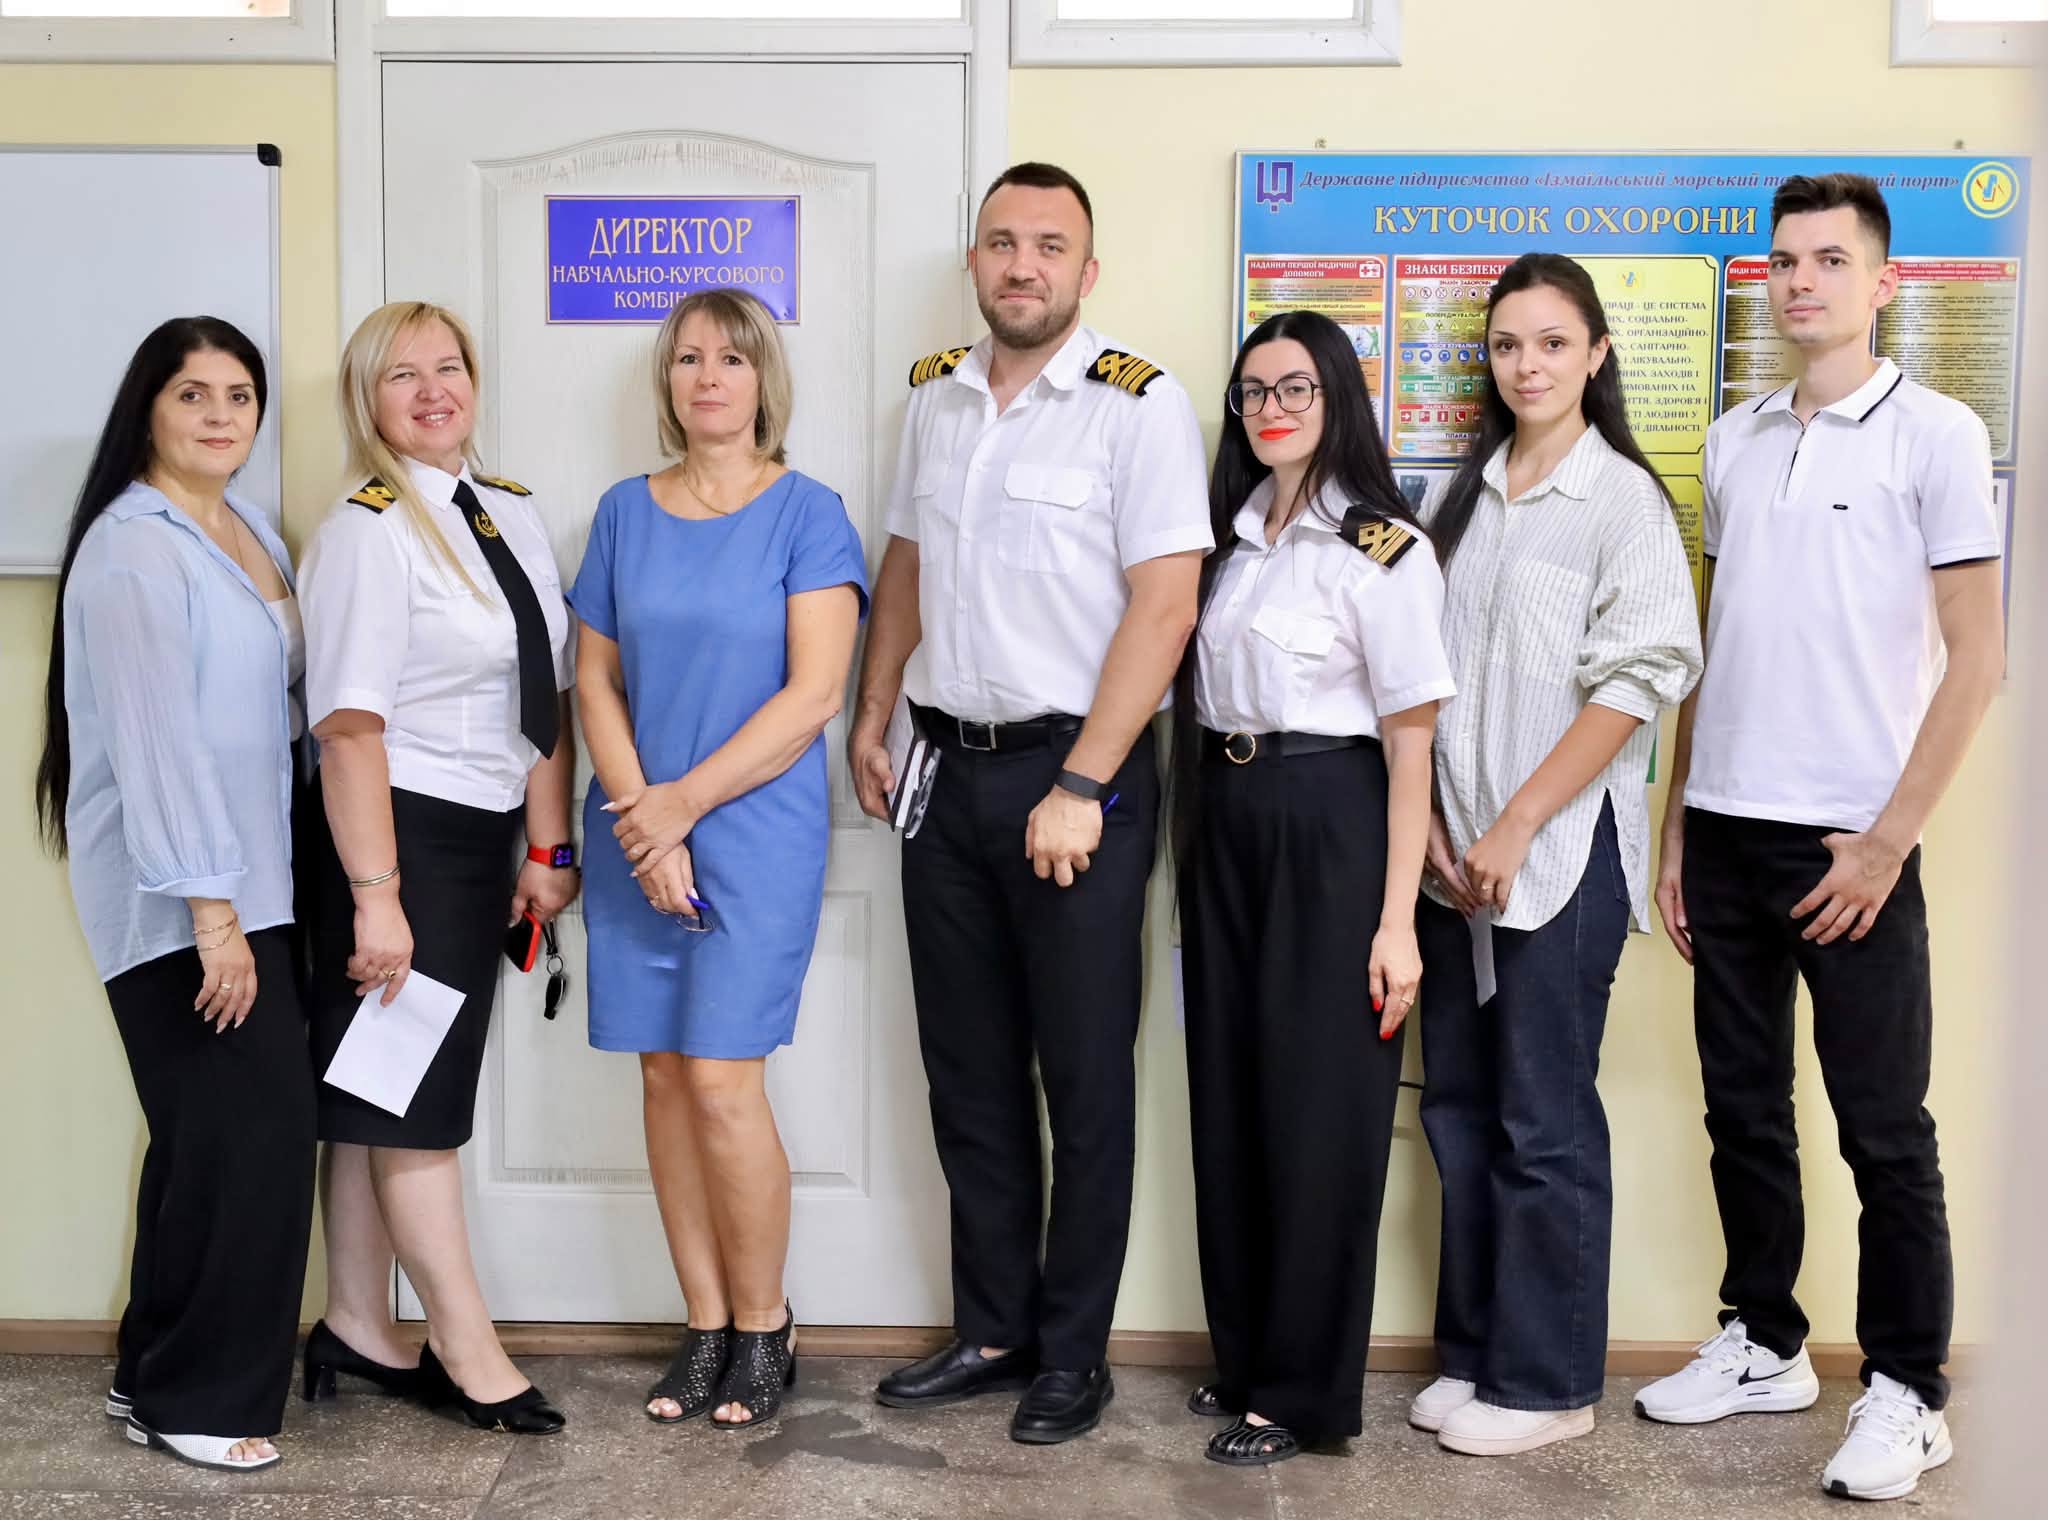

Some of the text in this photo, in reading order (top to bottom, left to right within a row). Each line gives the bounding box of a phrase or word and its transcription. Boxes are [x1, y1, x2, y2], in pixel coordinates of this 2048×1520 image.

[1300, 171, 1396, 190] Державне
[1399, 171, 1530, 190] підприємство
[1534, 172, 1665, 188] «Ізмаїльський
[1671, 172, 1759, 191] морський
[1900, 174, 1959, 191] порт»
[1373, 206, 1551, 234] КУТОЧОК
[1565, 206, 1757, 235] ОХОРОНИ
[588, 216, 753, 260] ДИРЕКТОР
[1250, 261, 1287, 269] НАДАННЯ
[1287, 260, 1317, 269] ПЕРШОЇ
[1404, 264, 1506, 275] ЗНАКИ БЕЗПЕКИ
[553, 265, 785, 285] НАВЧАЛЬНО-КУРСОВОГО
[1282, 270, 1325, 278] ДОПОМОГИ
[614, 291, 688, 310] КОМБІН
[1643, 302, 1657, 311] ЦЕ
[1659, 302, 1707, 310] СИСТЕМА
[1628, 315, 1688, 324] СОЦІАЛЬНО-
[1650, 370, 1692, 378] ЗАХОДІВ
[1644, 410, 1688, 419] ЛЮДИНИ
[1691, 410, 1697, 418] У
